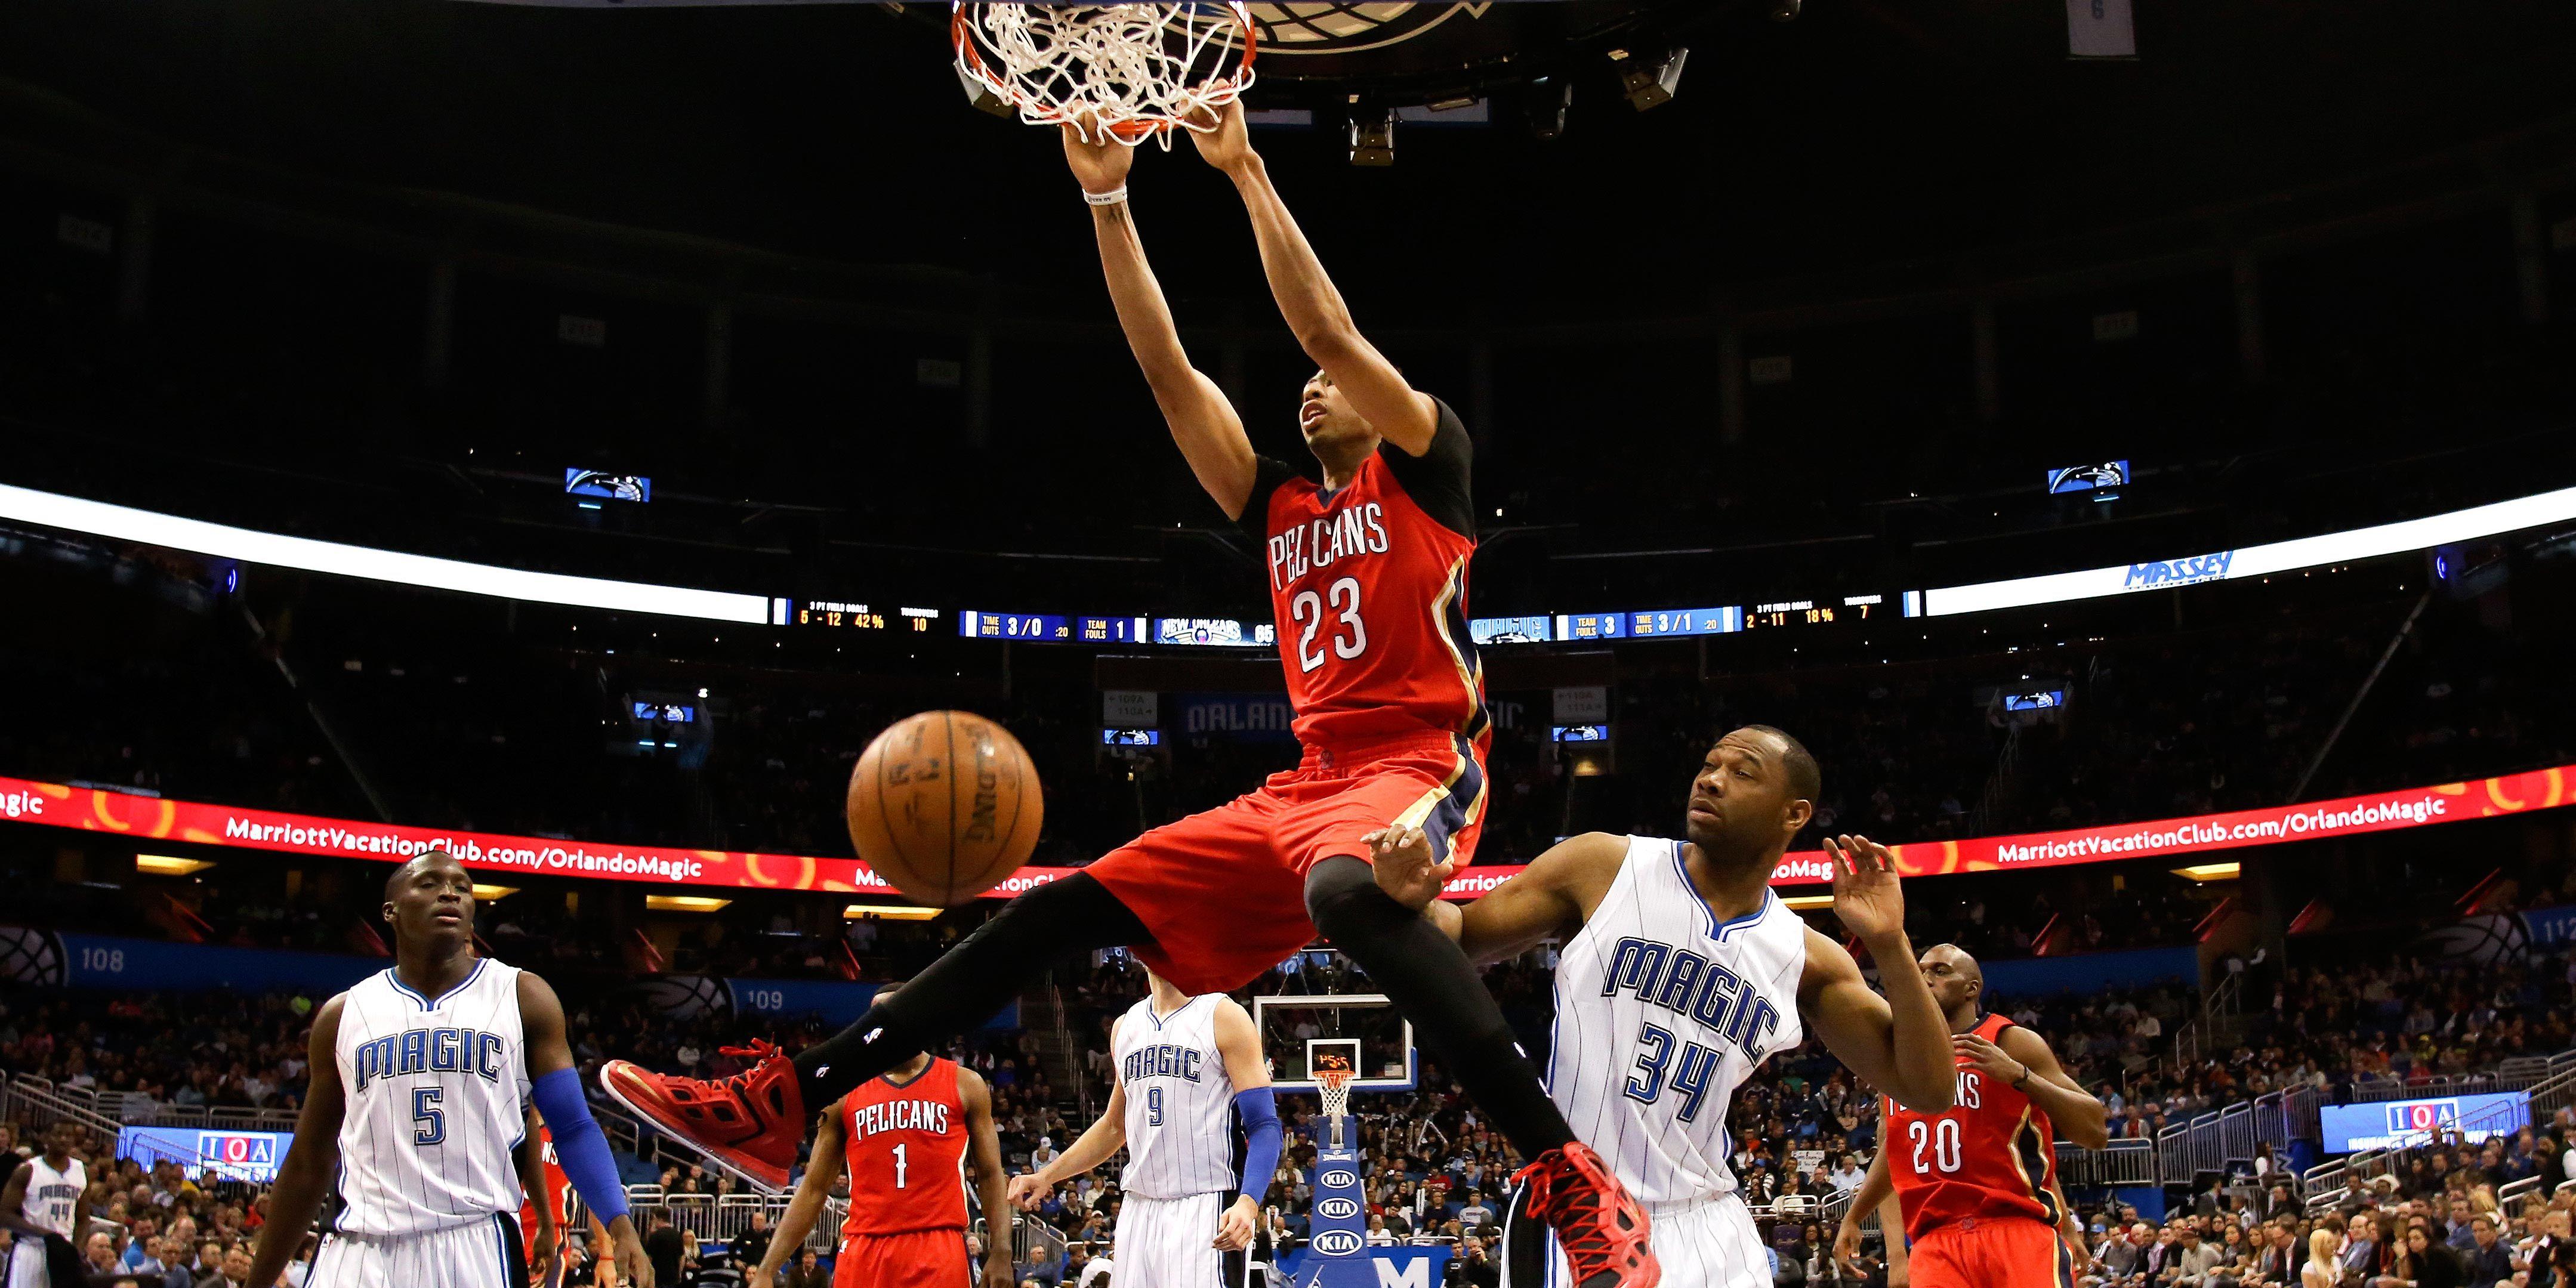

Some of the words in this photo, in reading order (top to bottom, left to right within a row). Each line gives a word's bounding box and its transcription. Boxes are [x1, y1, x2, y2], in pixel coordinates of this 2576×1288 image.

[1269, 502, 1389, 591] PELCANS
[2124, 550, 2234, 587] MASSEY
[800, 610, 809, 624] 5
[827, 611, 841, 626] 12
[983, 615, 999, 626] TIME
[1577, 617, 1597, 627] TEAM
[1635, 614, 1652, 625] TIME
[1746, 614, 1755, 628] 2
[1770, 612, 1784, 626] 11
[1859, 605, 1869, 619] 7
[913, 617, 927, 632] 10
[982, 625, 999, 636] OUTS
[1087, 619, 1107, 629] TEAM
[1116, 620, 1124, 639] 1
[1161, 618, 1189, 635] NEW
[1292, 576, 1367, 674] 23
[1575, 626, 1597, 637] FOULS
[1604, 615, 1616, 635] 3
[1634, 624, 1653, 634] OUTS
[1085, 629, 1107, 640] FOULS
[1187, 702, 1291, 733] ORLAN
[1997, 796, 2446, 863] MarriottVacationClub.com/OrlandoMagic
[82, 947, 124, 973] 108
[748, 990, 783, 1010] 109
[1600, 936, 1781, 1070] MAGIC
[355, 1027, 504, 1093] MAGIC
[1124, 1044, 1201, 1088] MAGIC
[1622, 1021, 1723, 1123] 34
[1147, 1086, 1164, 1126] 9
[412, 1086, 446, 1147] 5
[854, 1099, 949, 1141] PELICANS
[2395, 1104, 2454, 1129] IOA
[209, 1137, 270, 1162] IOA
[1908, 1118, 1962, 1175] 20
[891, 1142, 908, 1190] 1
[1326, 1173, 1350, 1185] KIA
[51, 1204, 70, 1221] 44
[1324, 1202, 1352, 1215] KIA
[1321, 1236, 1355, 1251] KIA
